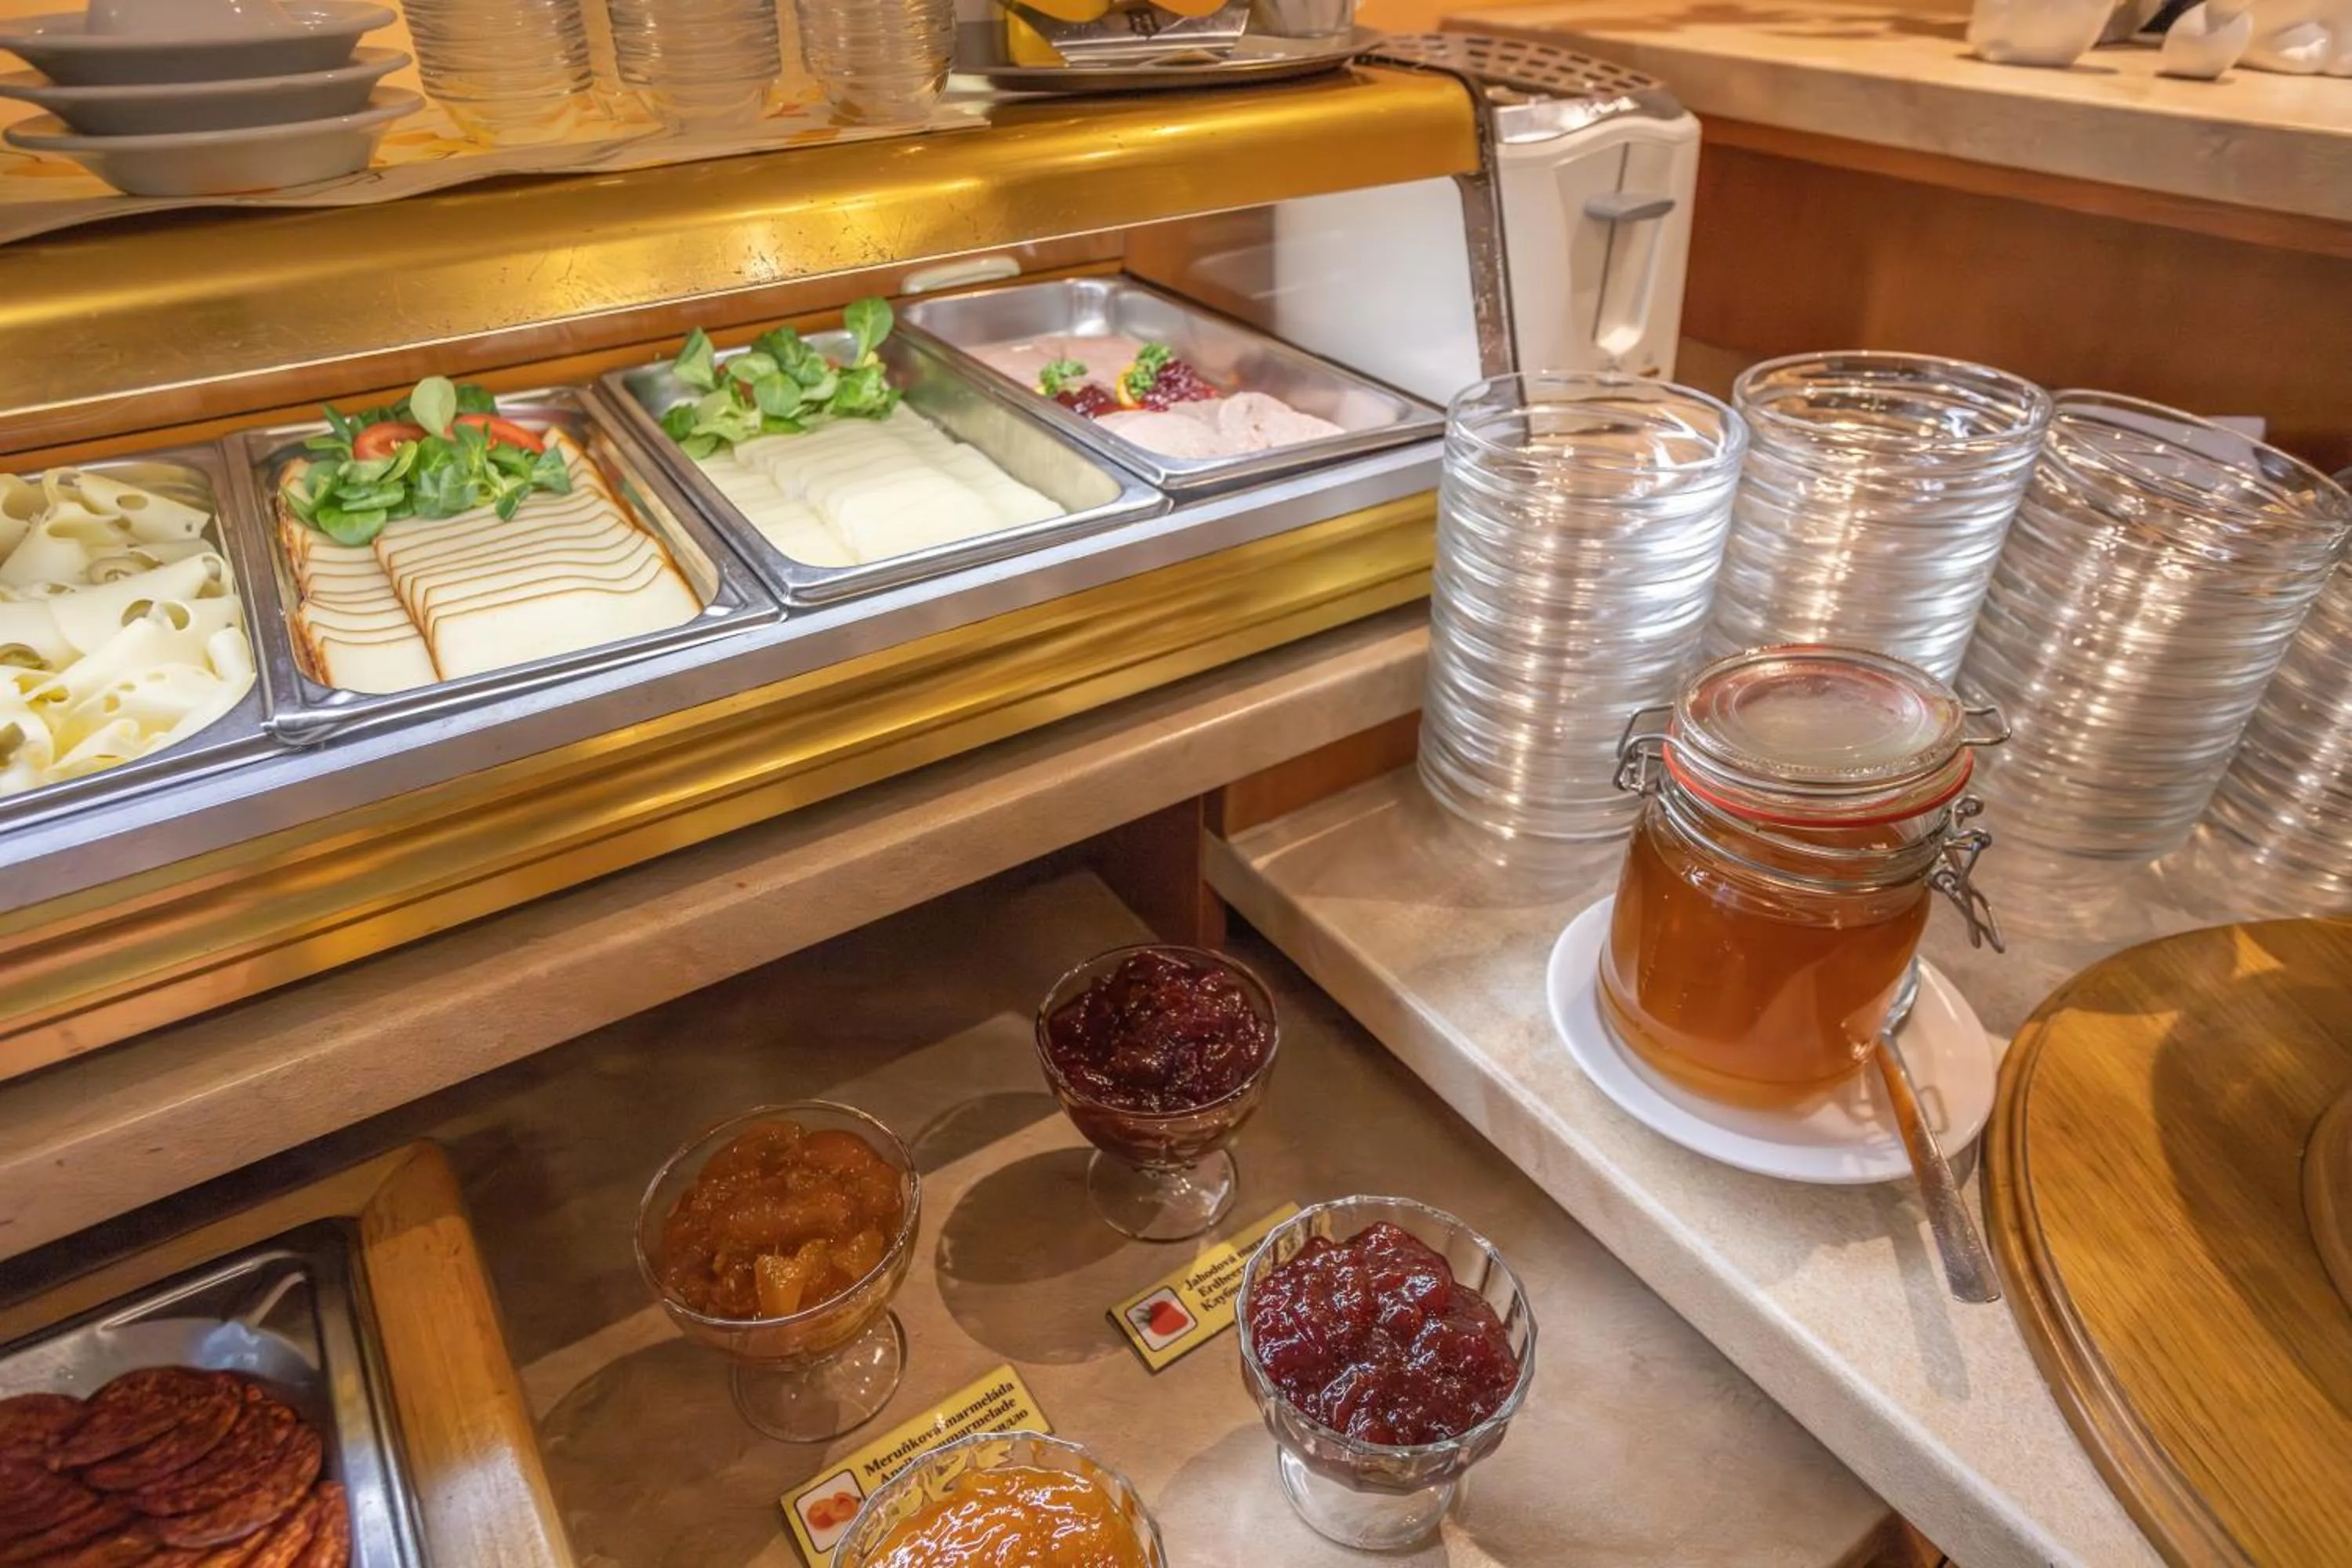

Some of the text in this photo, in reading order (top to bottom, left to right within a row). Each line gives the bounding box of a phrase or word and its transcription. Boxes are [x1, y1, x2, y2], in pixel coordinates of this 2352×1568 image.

[1185, 1254, 1236, 1291] Jahodová
[863, 1382, 1015, 1477] Meruňková marmeláda
